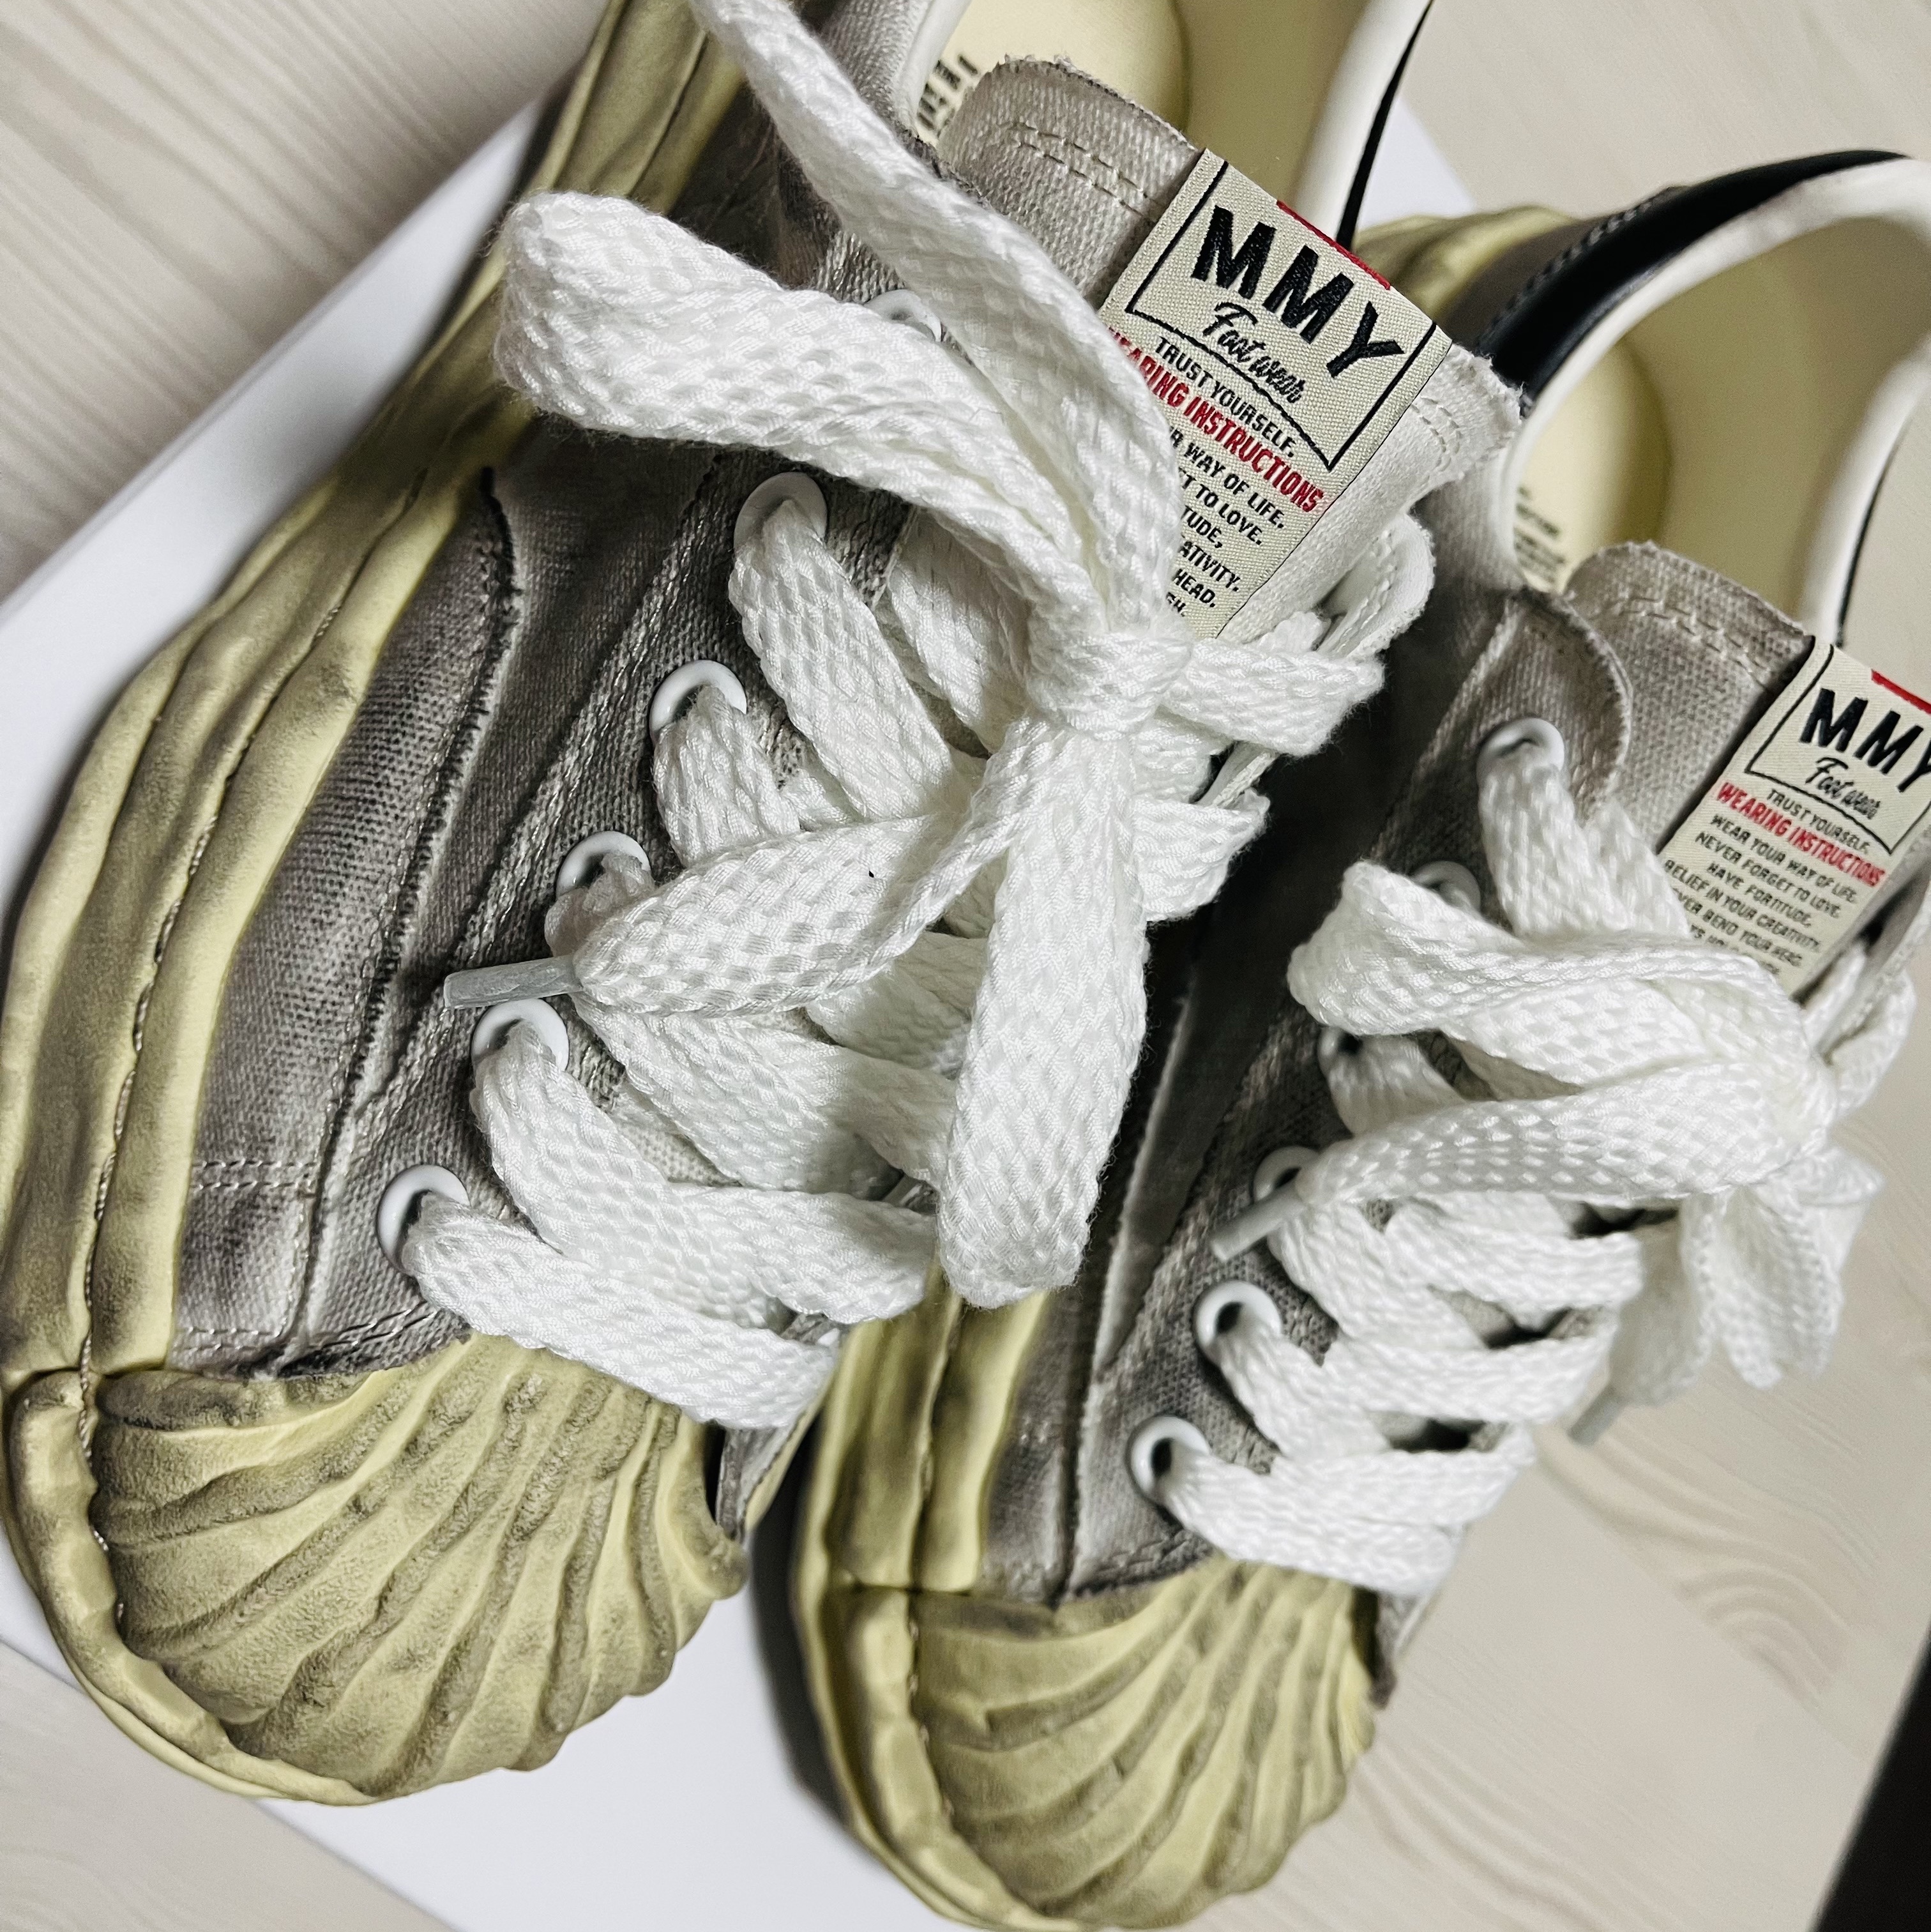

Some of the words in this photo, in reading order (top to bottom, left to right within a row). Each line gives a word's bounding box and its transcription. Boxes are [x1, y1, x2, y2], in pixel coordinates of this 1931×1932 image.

[1191, 205, 1405, 378] MMY
[1155, 336, 1213, 388] TRUST
[1210, 381, 1297, 458] YOURSELF.
[1183, 396, 1324, 513] INSTRUCTIONS
[1184, 442, 1226, 478] WAY
[1223, 473, 1250, 496] OF
[1247, 492, 1285, 529] LIFE.
[1195, 483, 1220, 508] TO
[1218, 503, 1263, 546] LOVE.
[1716, 782, 1792, 837] WEARING
[1787, 826, 1886, 887] INSTRUCTIONS
[1767, 788, 1812, 821] TRUST
[1695, 832, 1743, 864] NEVER
[1741, 858, 1794, 894] FORGET
[1793, 886, 1812, 902] TO
[1706, 862, 1745, 890] HAVE
[1710, 813, 1752, 846] WEAR
[1750, 837, 1787, 867] YOUR
[1786, 860, 1818, 881] WAY
[1815, 874, 1835, 888] OF
[1664, 858, 1710, 892] BELIEF
[1705, 886, 1725, 904] IN
[1722, 895, 1759, 921] YOUR
[1702, 908, 1739, 936] BEND
